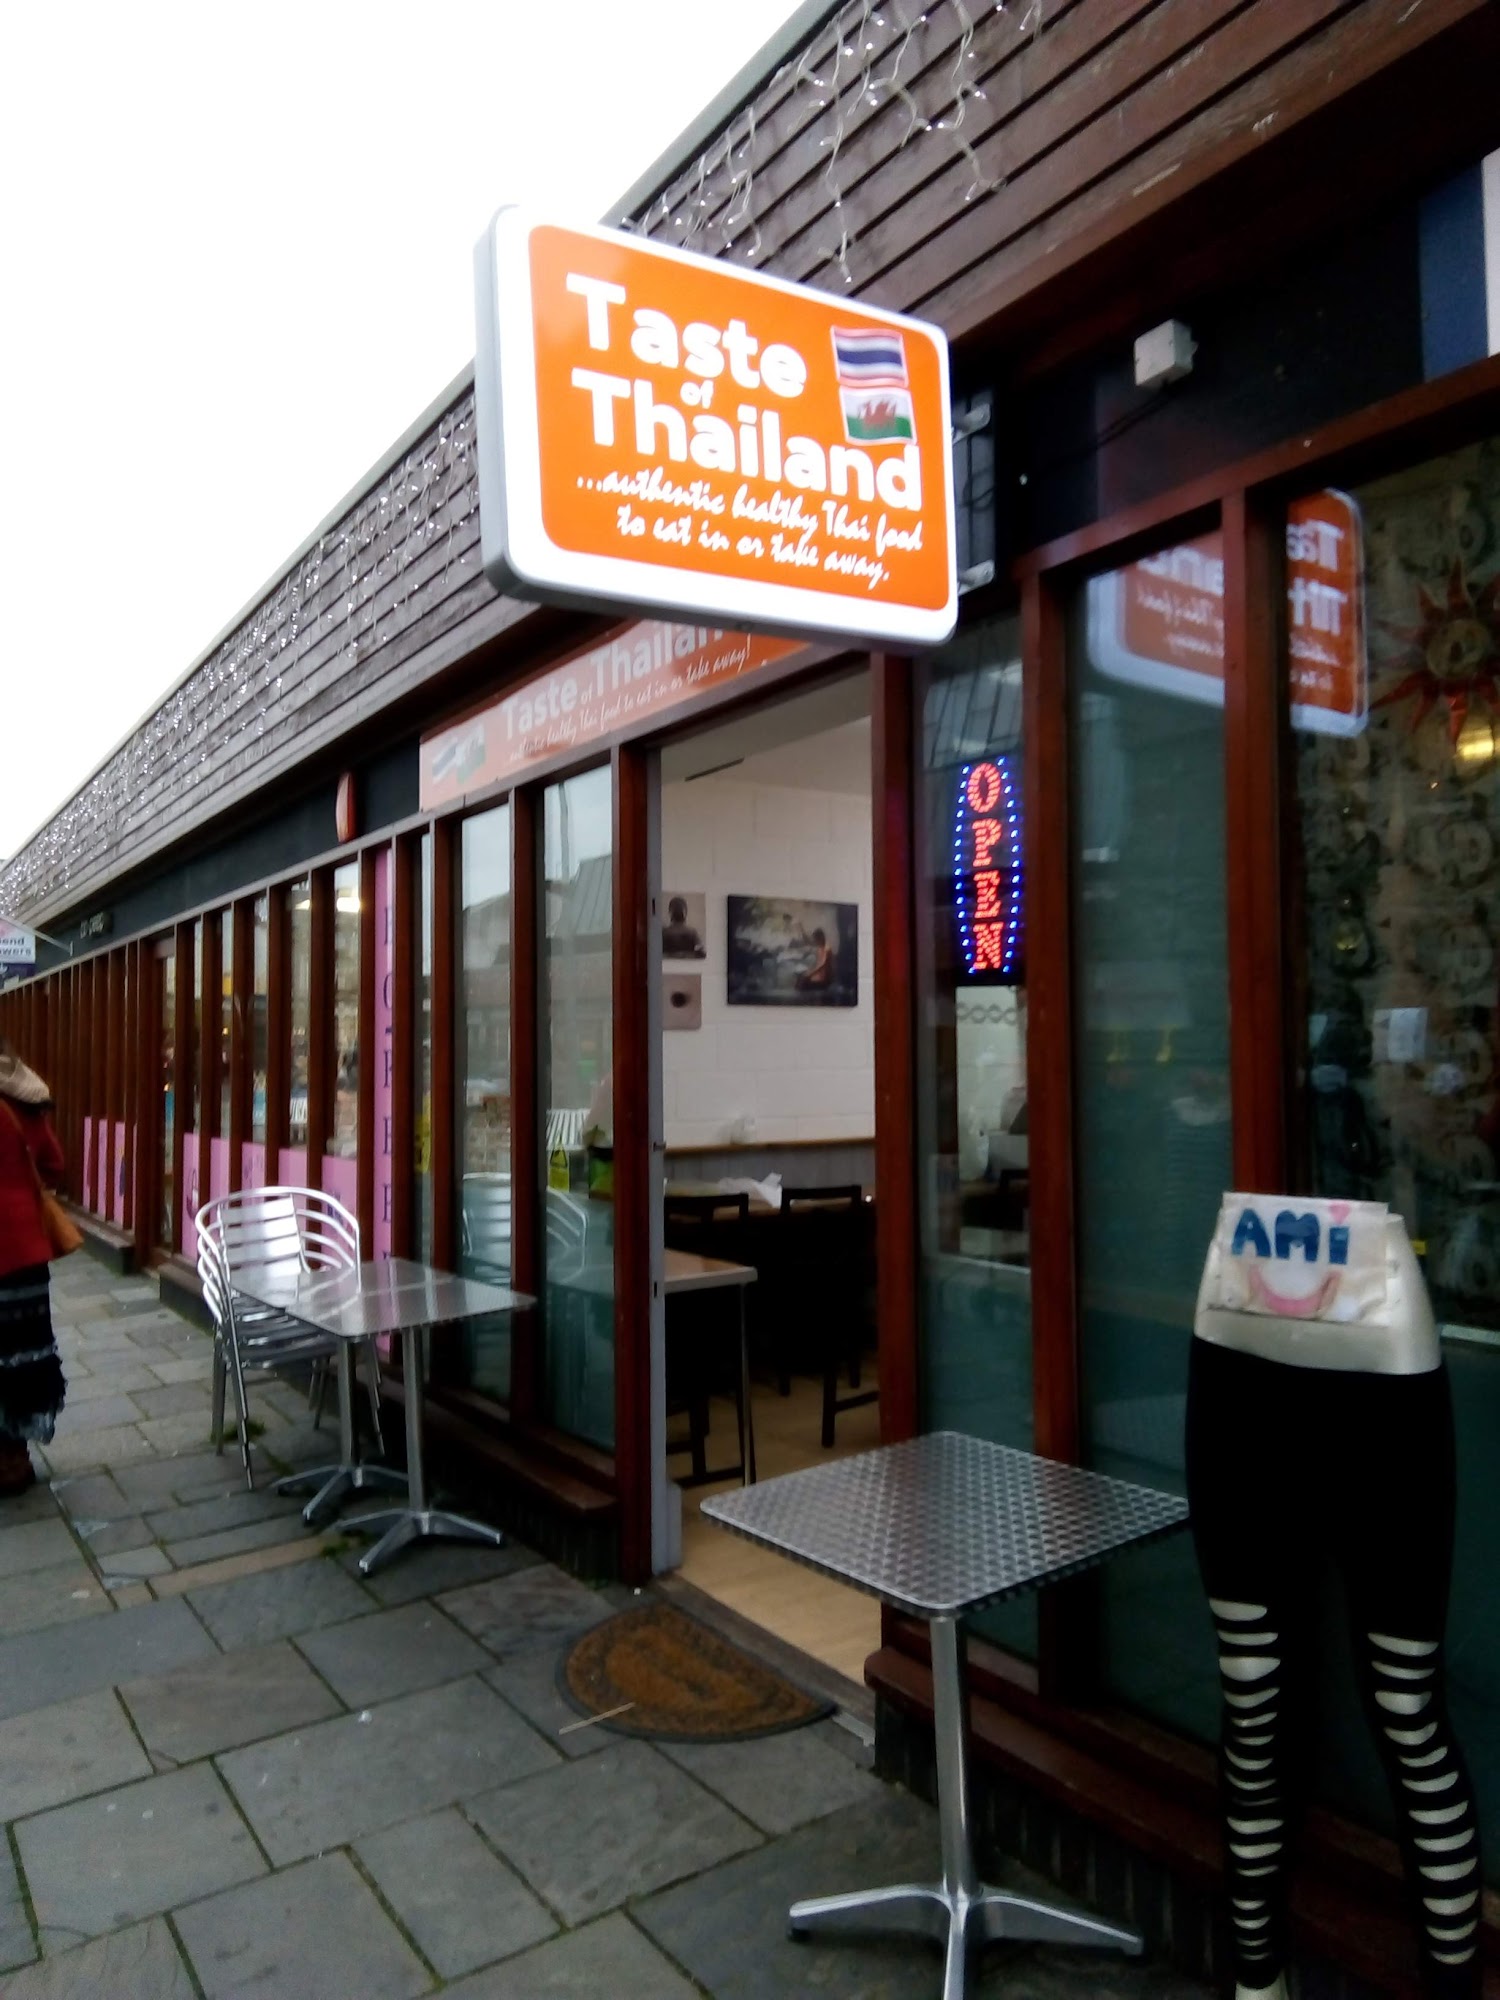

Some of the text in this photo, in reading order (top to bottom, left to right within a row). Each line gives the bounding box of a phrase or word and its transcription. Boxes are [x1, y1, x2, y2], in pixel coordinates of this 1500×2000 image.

[566, 272, 807, 399] Taste
[680, 380, 714, 409] of
[571, 367, 922, 511] Thailand
[617, 503, 890, 590] to eat in or take away.
[732, 483, 818, 545] healthy
[821, 500, 870, 542] Thai
[875, 513, 923, 557] food
[502, 622, 724, 740] Taste of Thaila
[967, 762, 1004, 970] OPEN
